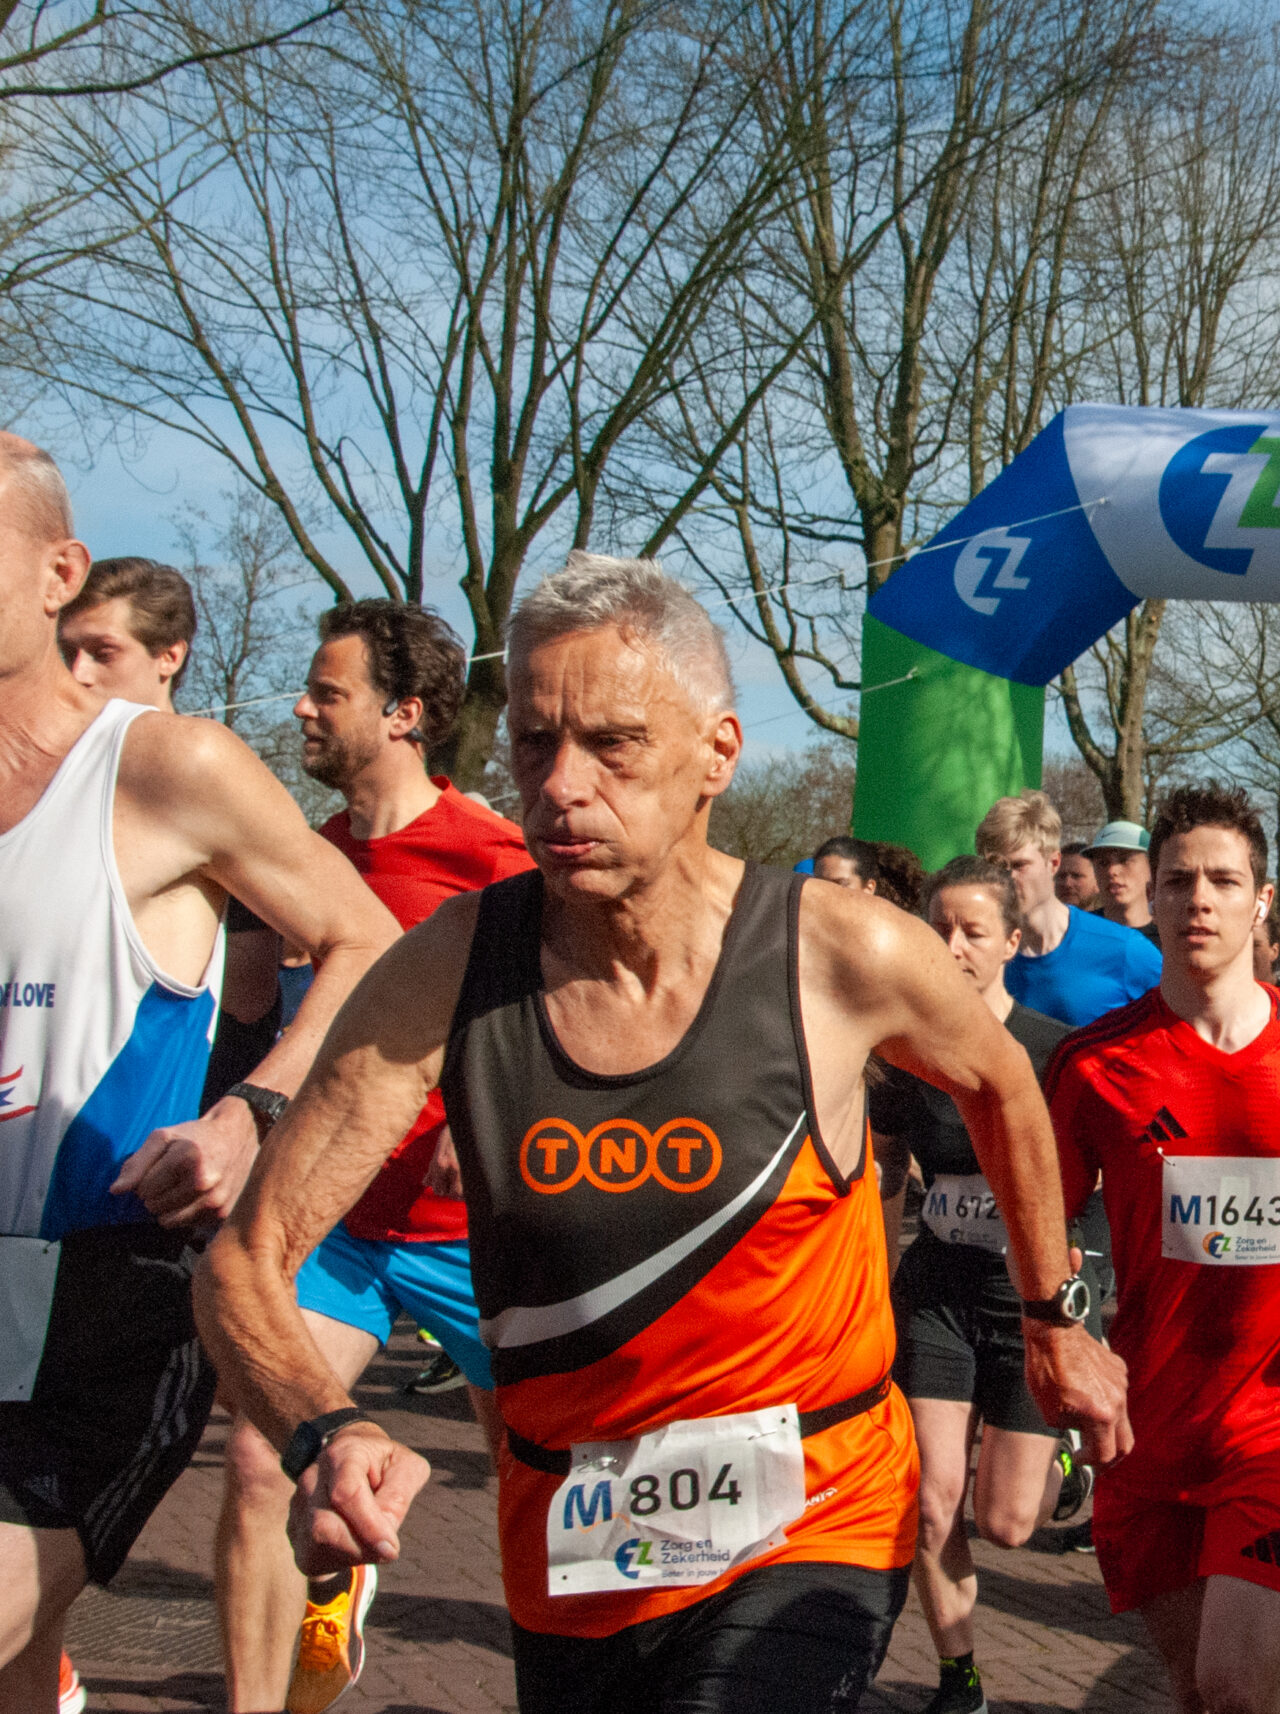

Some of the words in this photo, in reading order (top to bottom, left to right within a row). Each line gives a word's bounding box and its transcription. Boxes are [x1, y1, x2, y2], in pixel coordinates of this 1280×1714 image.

[536, 1137, 703, 1175] TNT
[956, 1195, 999, 1220] 672
[1235, 1236, 1255, 1246] Zorg
[630, 1463, 742, 1516] 804
[660, 1539, 693, 1552] Zorg
[696, 1539, 713, 1549] en
[661, 1549, 730, 1564] Zekerheid
